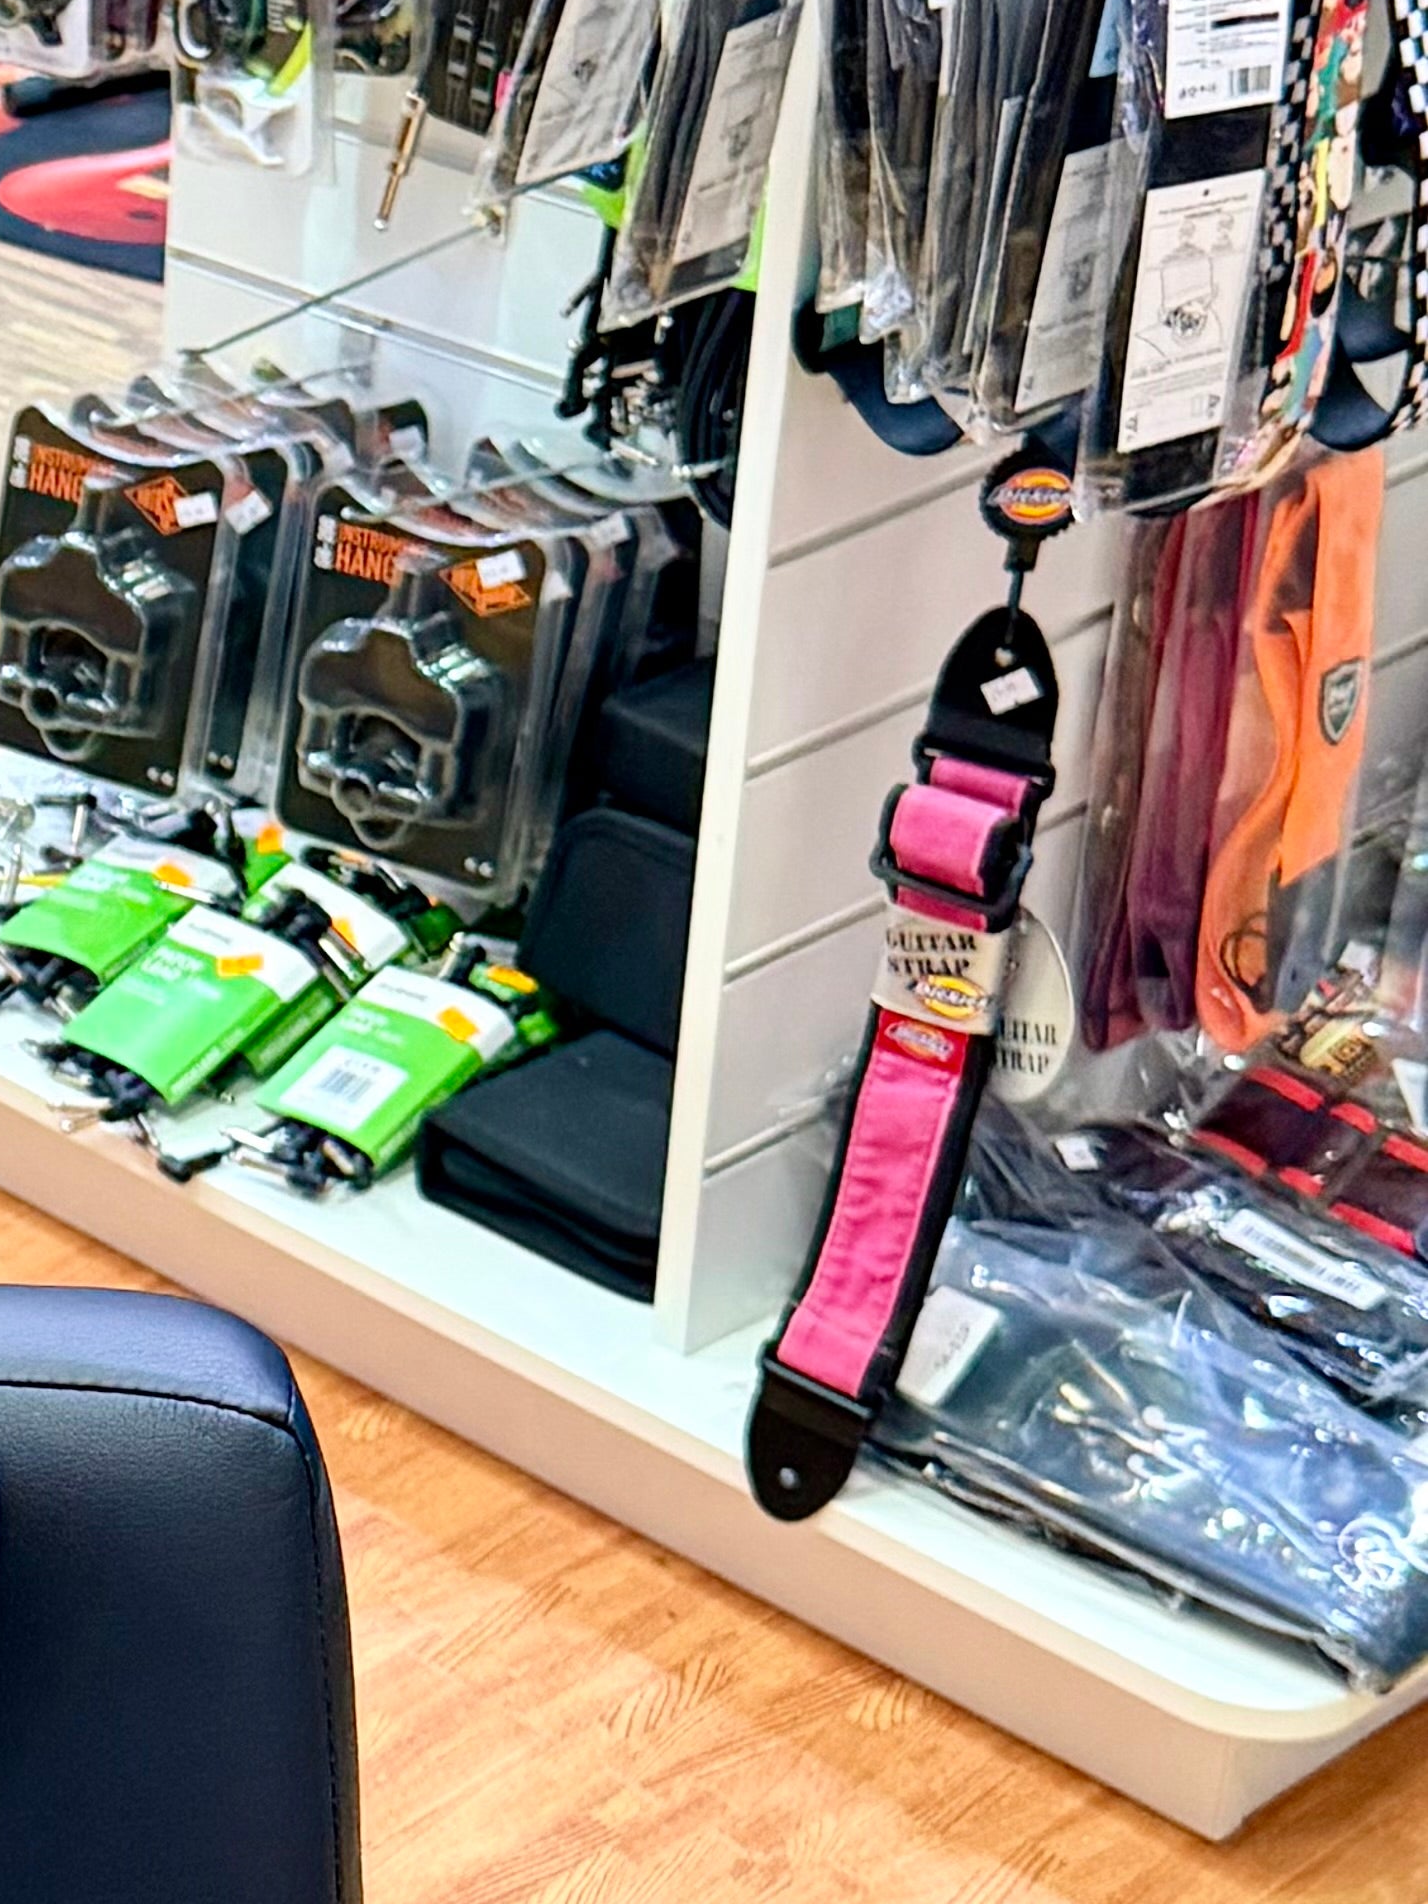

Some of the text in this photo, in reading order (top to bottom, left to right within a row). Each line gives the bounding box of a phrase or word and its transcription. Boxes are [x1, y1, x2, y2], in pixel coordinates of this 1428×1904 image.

[886, 929, 978, 952] GUITAR
[887, 956, 971, 977] STRAP
[995, 1017, 1058, 1046] UITAR
[994, 1046, 1050, 1074] TRAP
